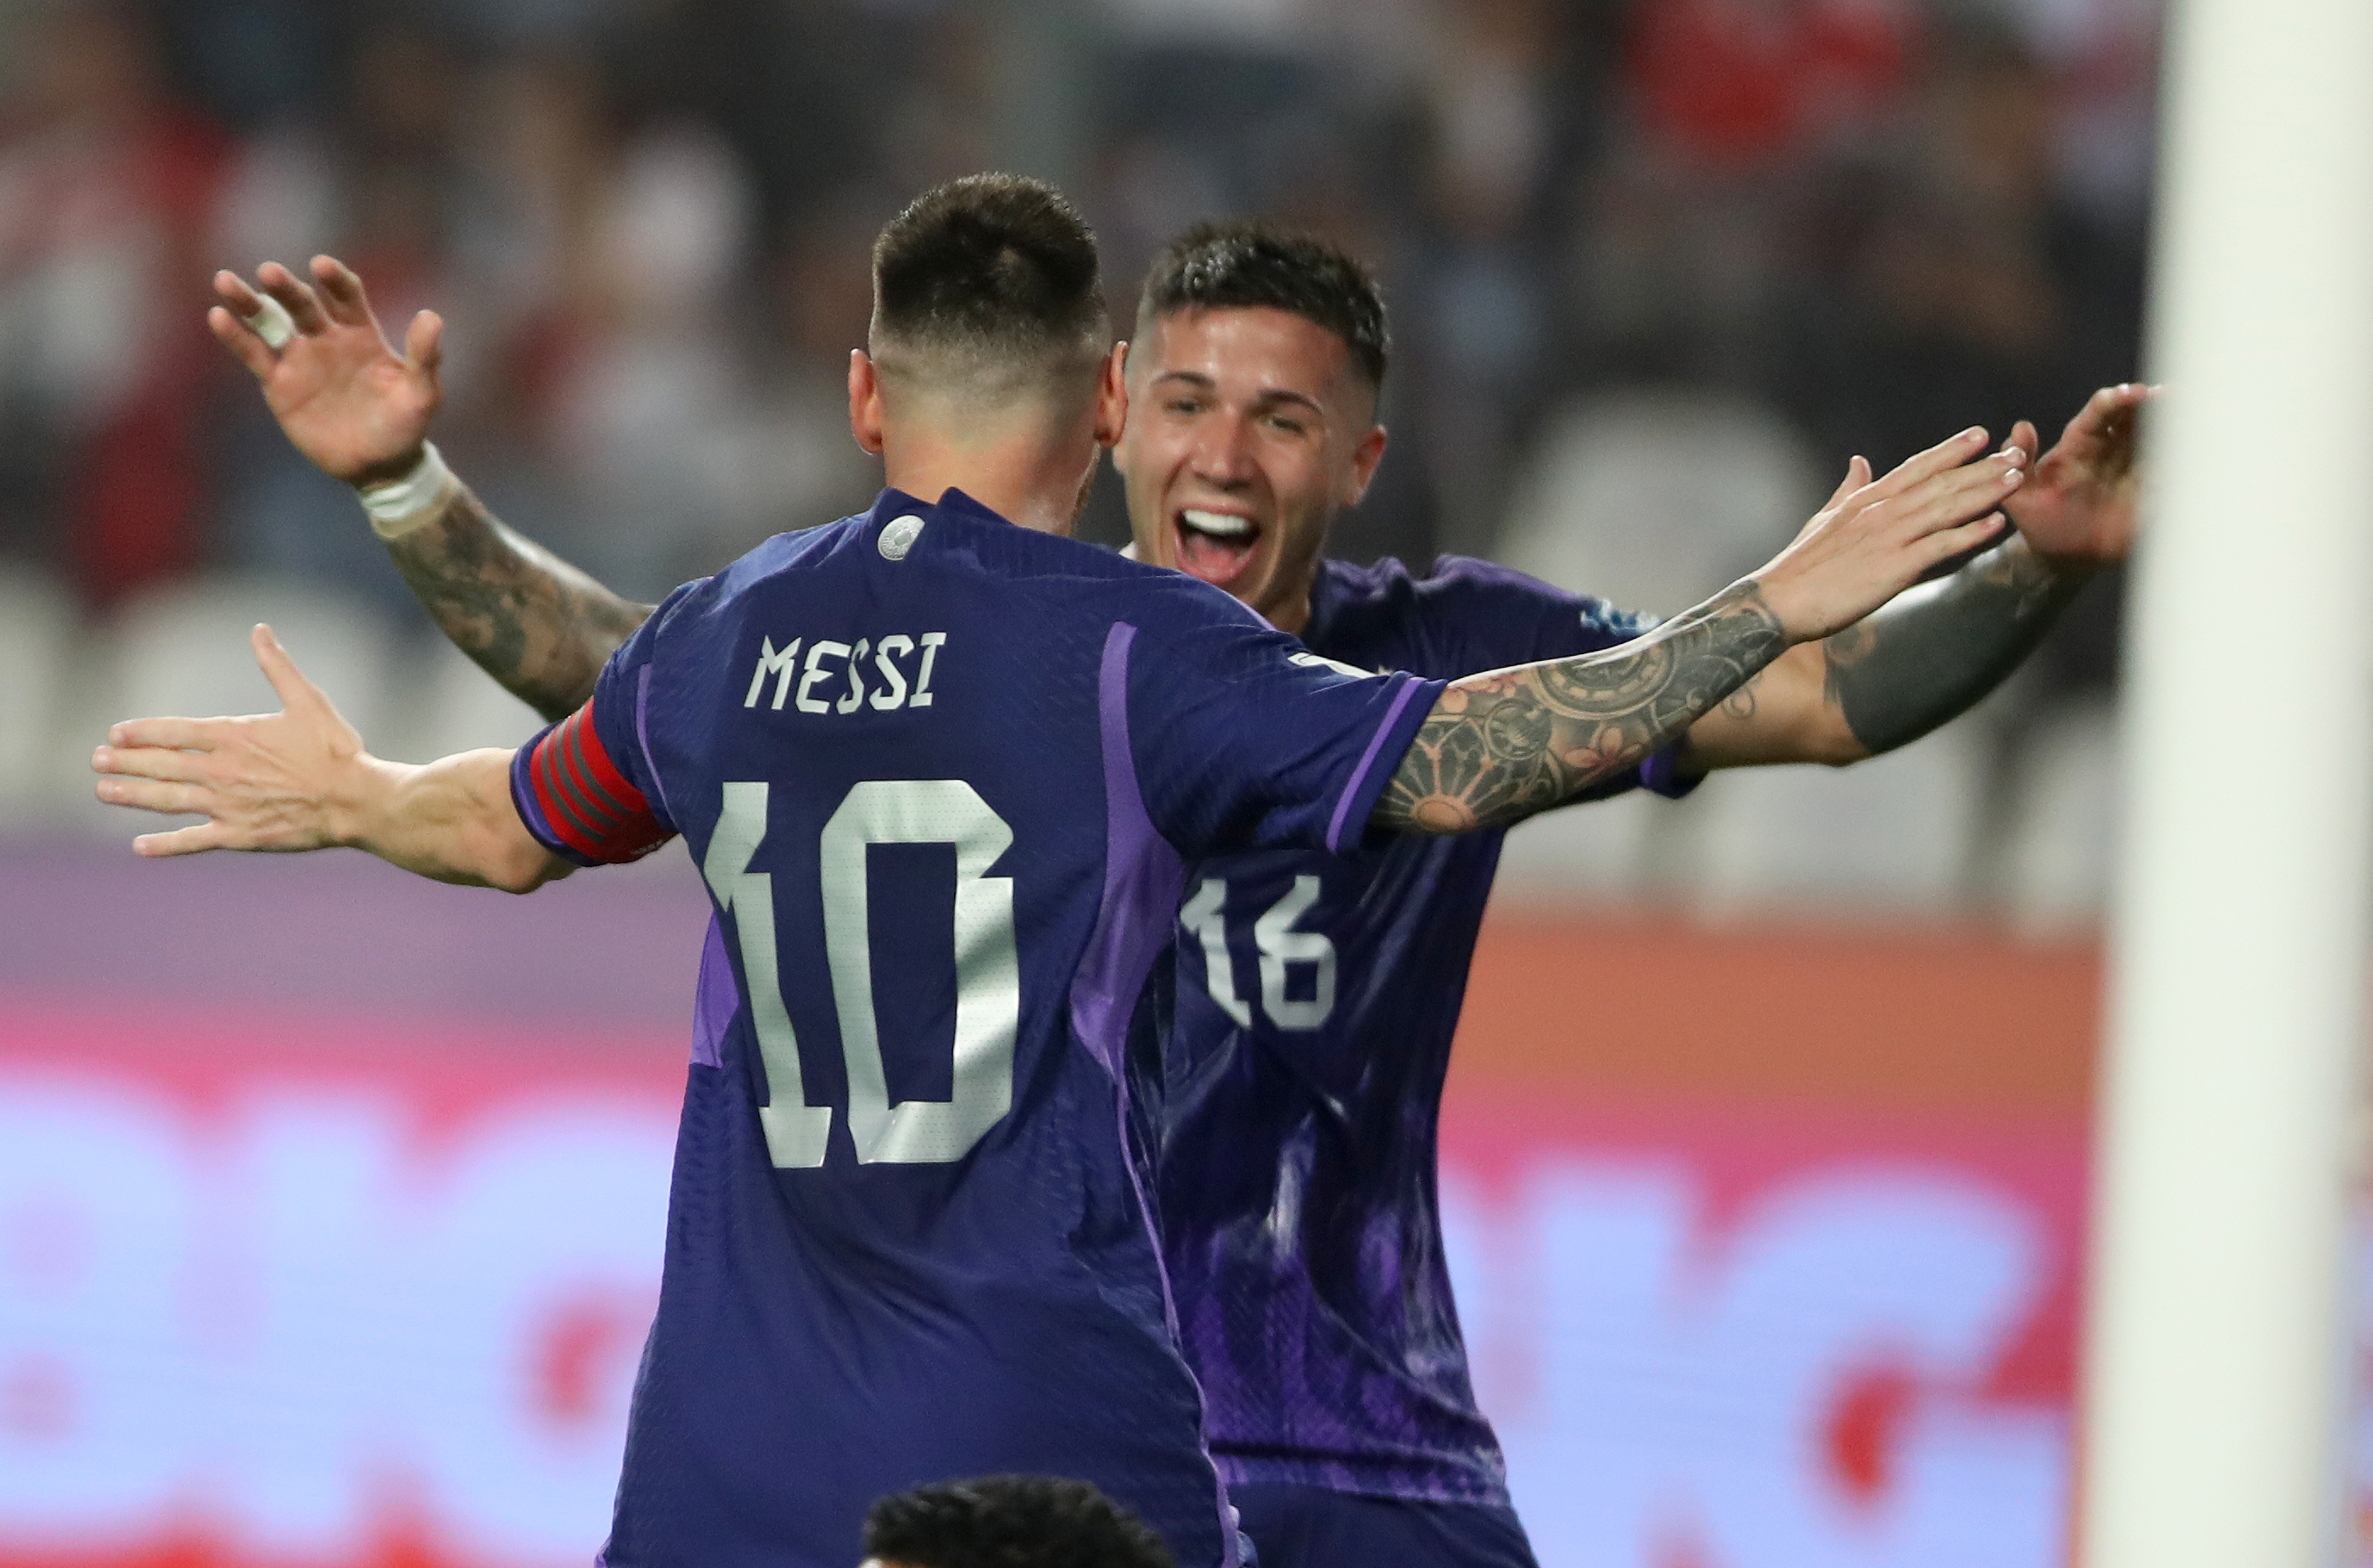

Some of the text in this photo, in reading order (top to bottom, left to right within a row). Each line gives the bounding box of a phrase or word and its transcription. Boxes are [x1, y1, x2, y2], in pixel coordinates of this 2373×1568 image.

[743, 631, 947, 715] MESSI
[703, 779, 1020, 1168] 10
[1179, 874, 1337, 1032] 16
